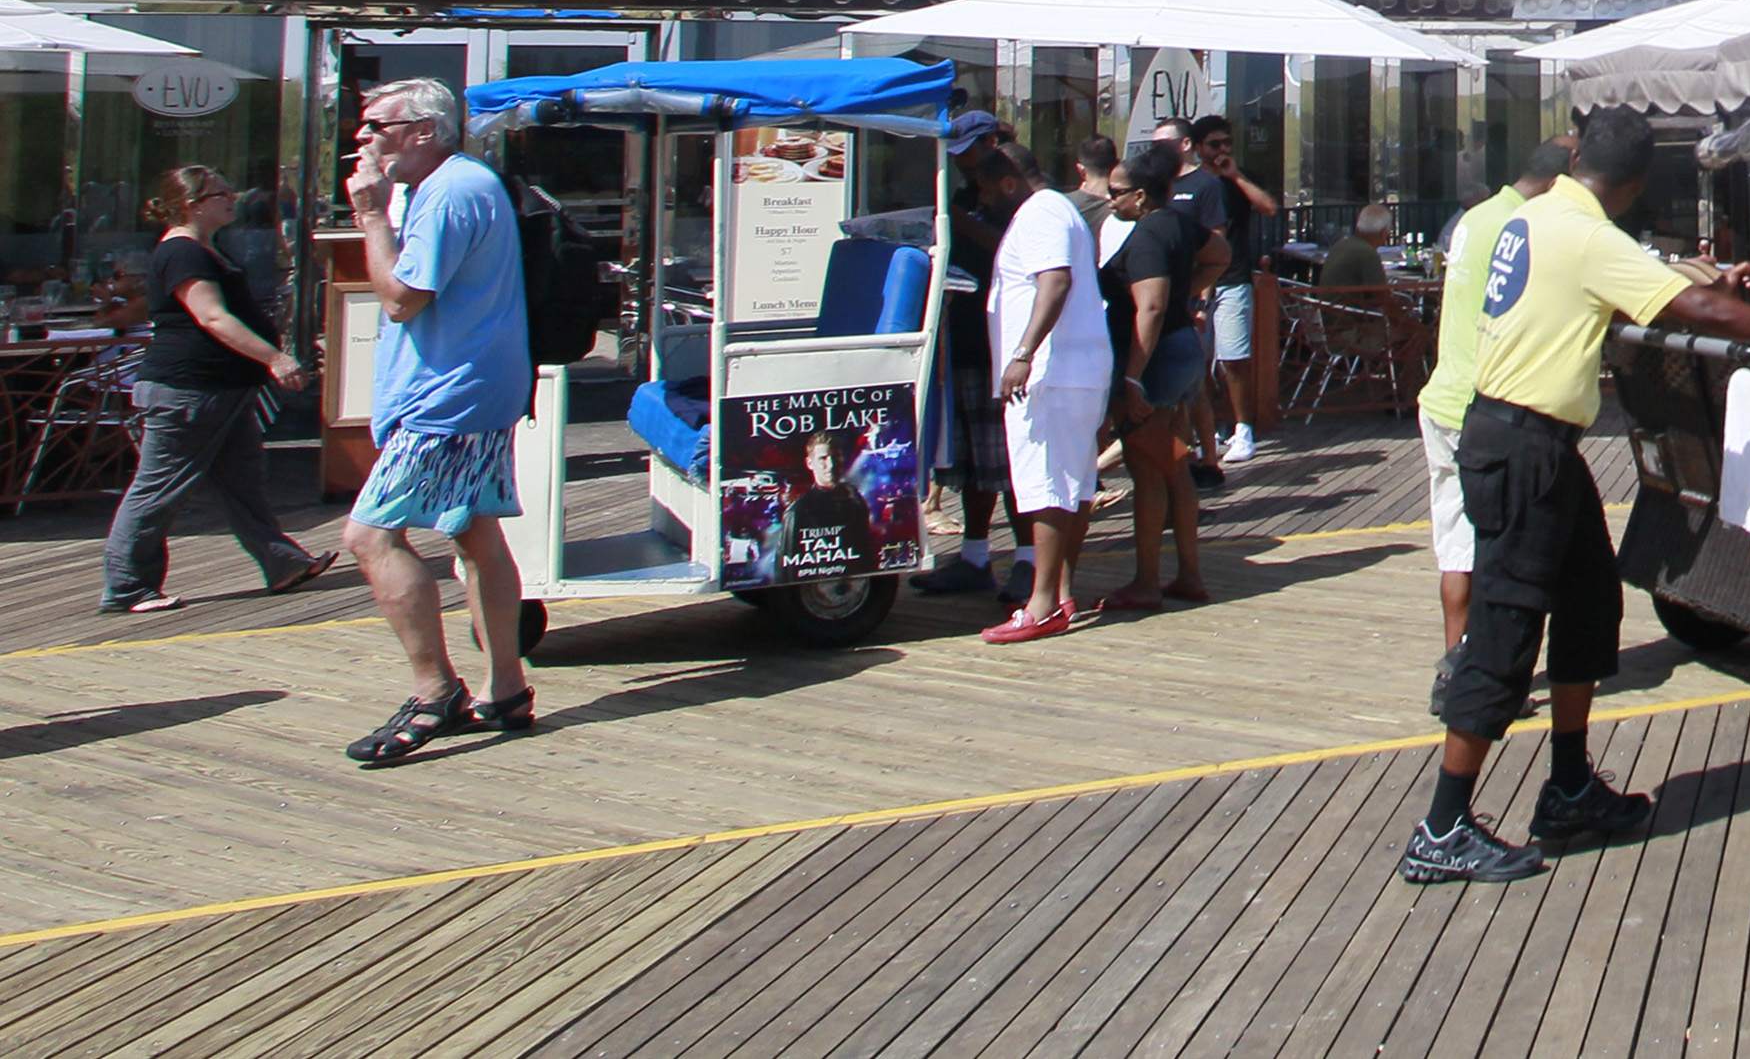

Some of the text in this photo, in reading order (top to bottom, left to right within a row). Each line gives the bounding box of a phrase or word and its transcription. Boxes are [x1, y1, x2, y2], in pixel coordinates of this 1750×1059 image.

[162, 74, 211, 108] EVO
[1151, 70, 1198, 121] EVO
[763, 197, 813, 207] Breakfast
[755, 226, 819, 237] Happy Hour
[1496, 231, 1526, 262] FLY
[752, 299, 818, 310] Lunch Menu
[744, 389, 894, 413] THE MAGIC OF
[750, 407, 889, 440] ROB LAKE
[799, 526, 844, 539] TRUMP
[801, 536, 840, 552] TAJ
[783, 547, 860, 567] MAHAL
[818, 565, 847, 575] Nightly
